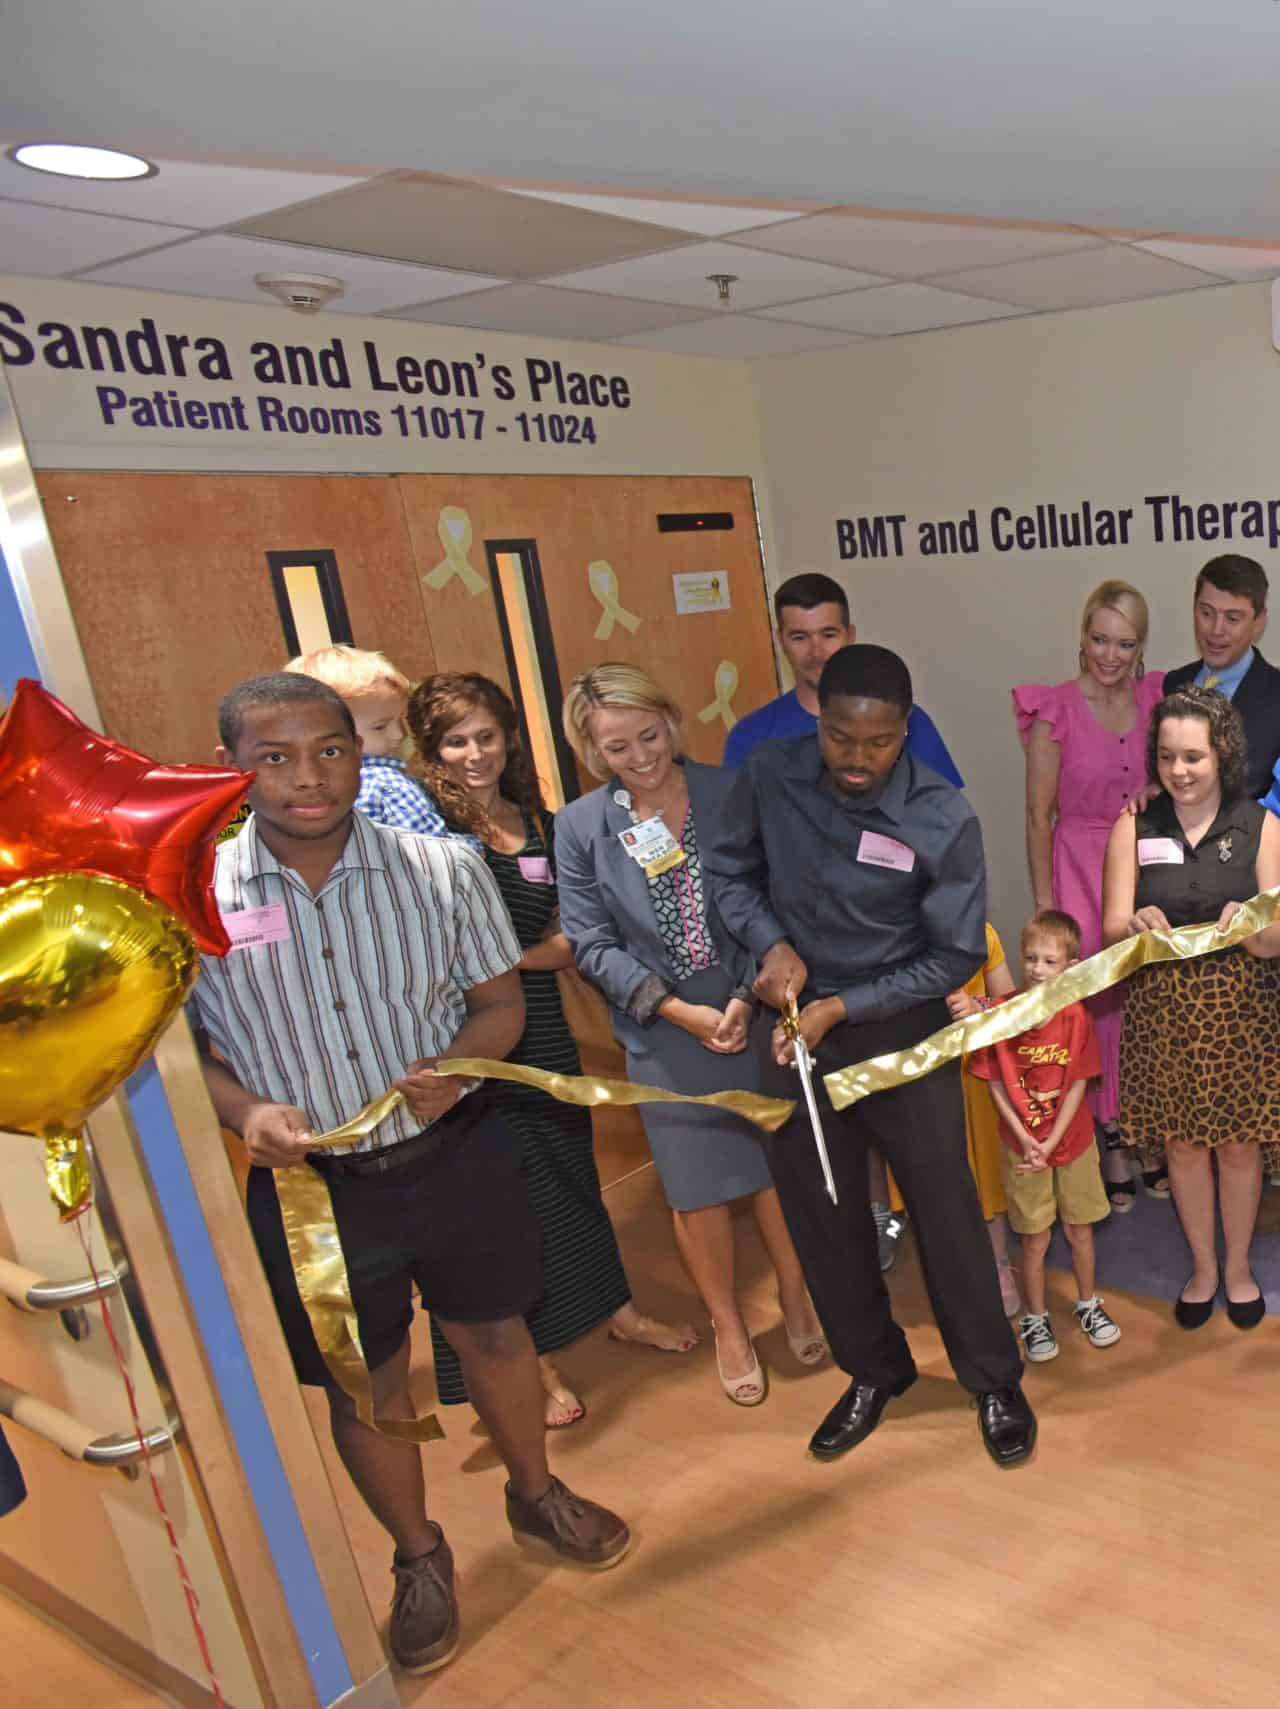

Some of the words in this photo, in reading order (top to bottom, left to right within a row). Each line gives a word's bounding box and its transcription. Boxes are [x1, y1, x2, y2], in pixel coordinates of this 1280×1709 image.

[0, 302, 233, 381] Sandra
[250, 337, 352, 389] and
[363, 340, 516, 401] Leon's
[525, 358, 631, 408] Place
[96, 386, 249, 431] Patient
[257, 396, 383, 437] Rooms
[391, 404, 485, 440] 11017
[515, 411, 597, 445] 11024
[836, 514, 906, 560] BMT
[918, 509, 980, 556] and
[991, 502, 1134, 553] Cellular
